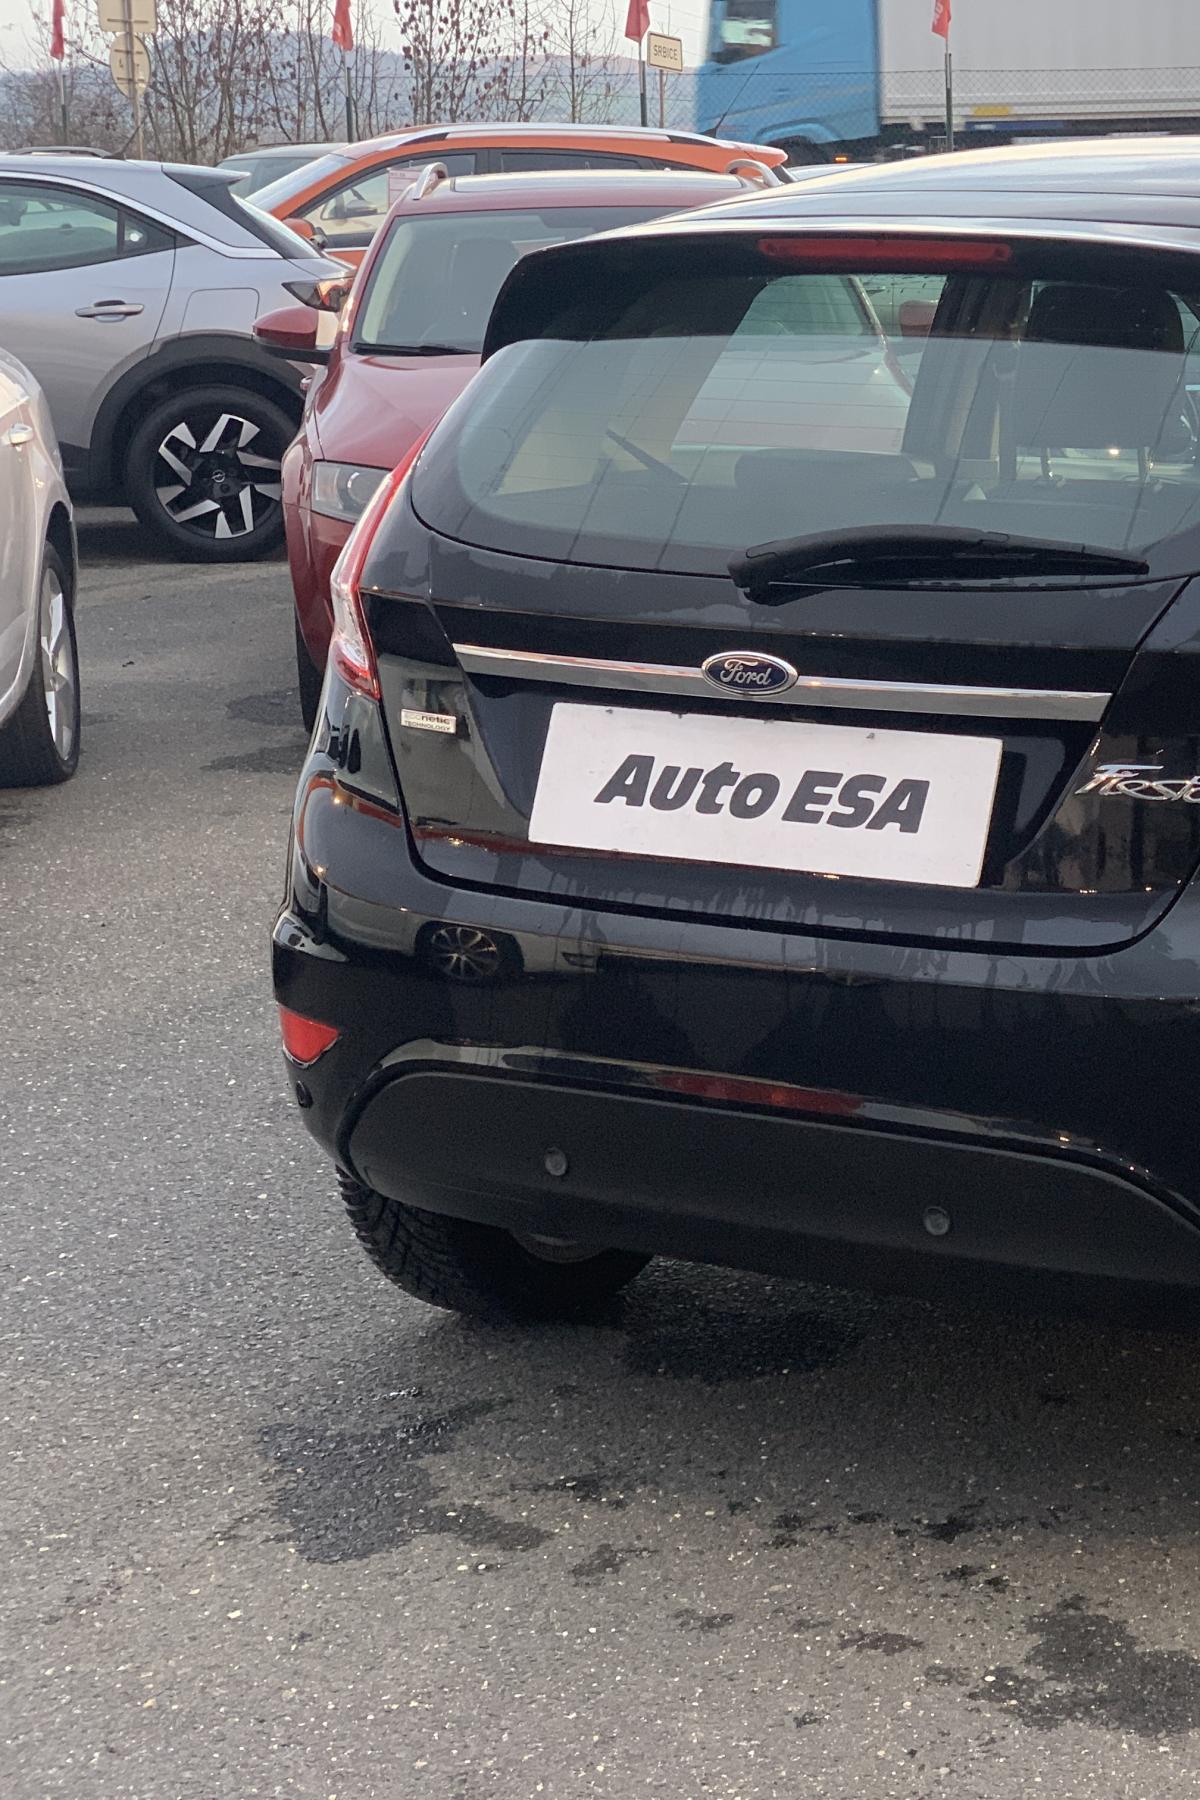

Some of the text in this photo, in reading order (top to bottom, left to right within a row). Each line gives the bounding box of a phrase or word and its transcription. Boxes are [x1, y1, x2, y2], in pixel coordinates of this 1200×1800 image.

[653, 44, 678, 60] SRBICE
[720, 658, 772, 686] Ford
[593, 754, 930, 833] Auto ESA
